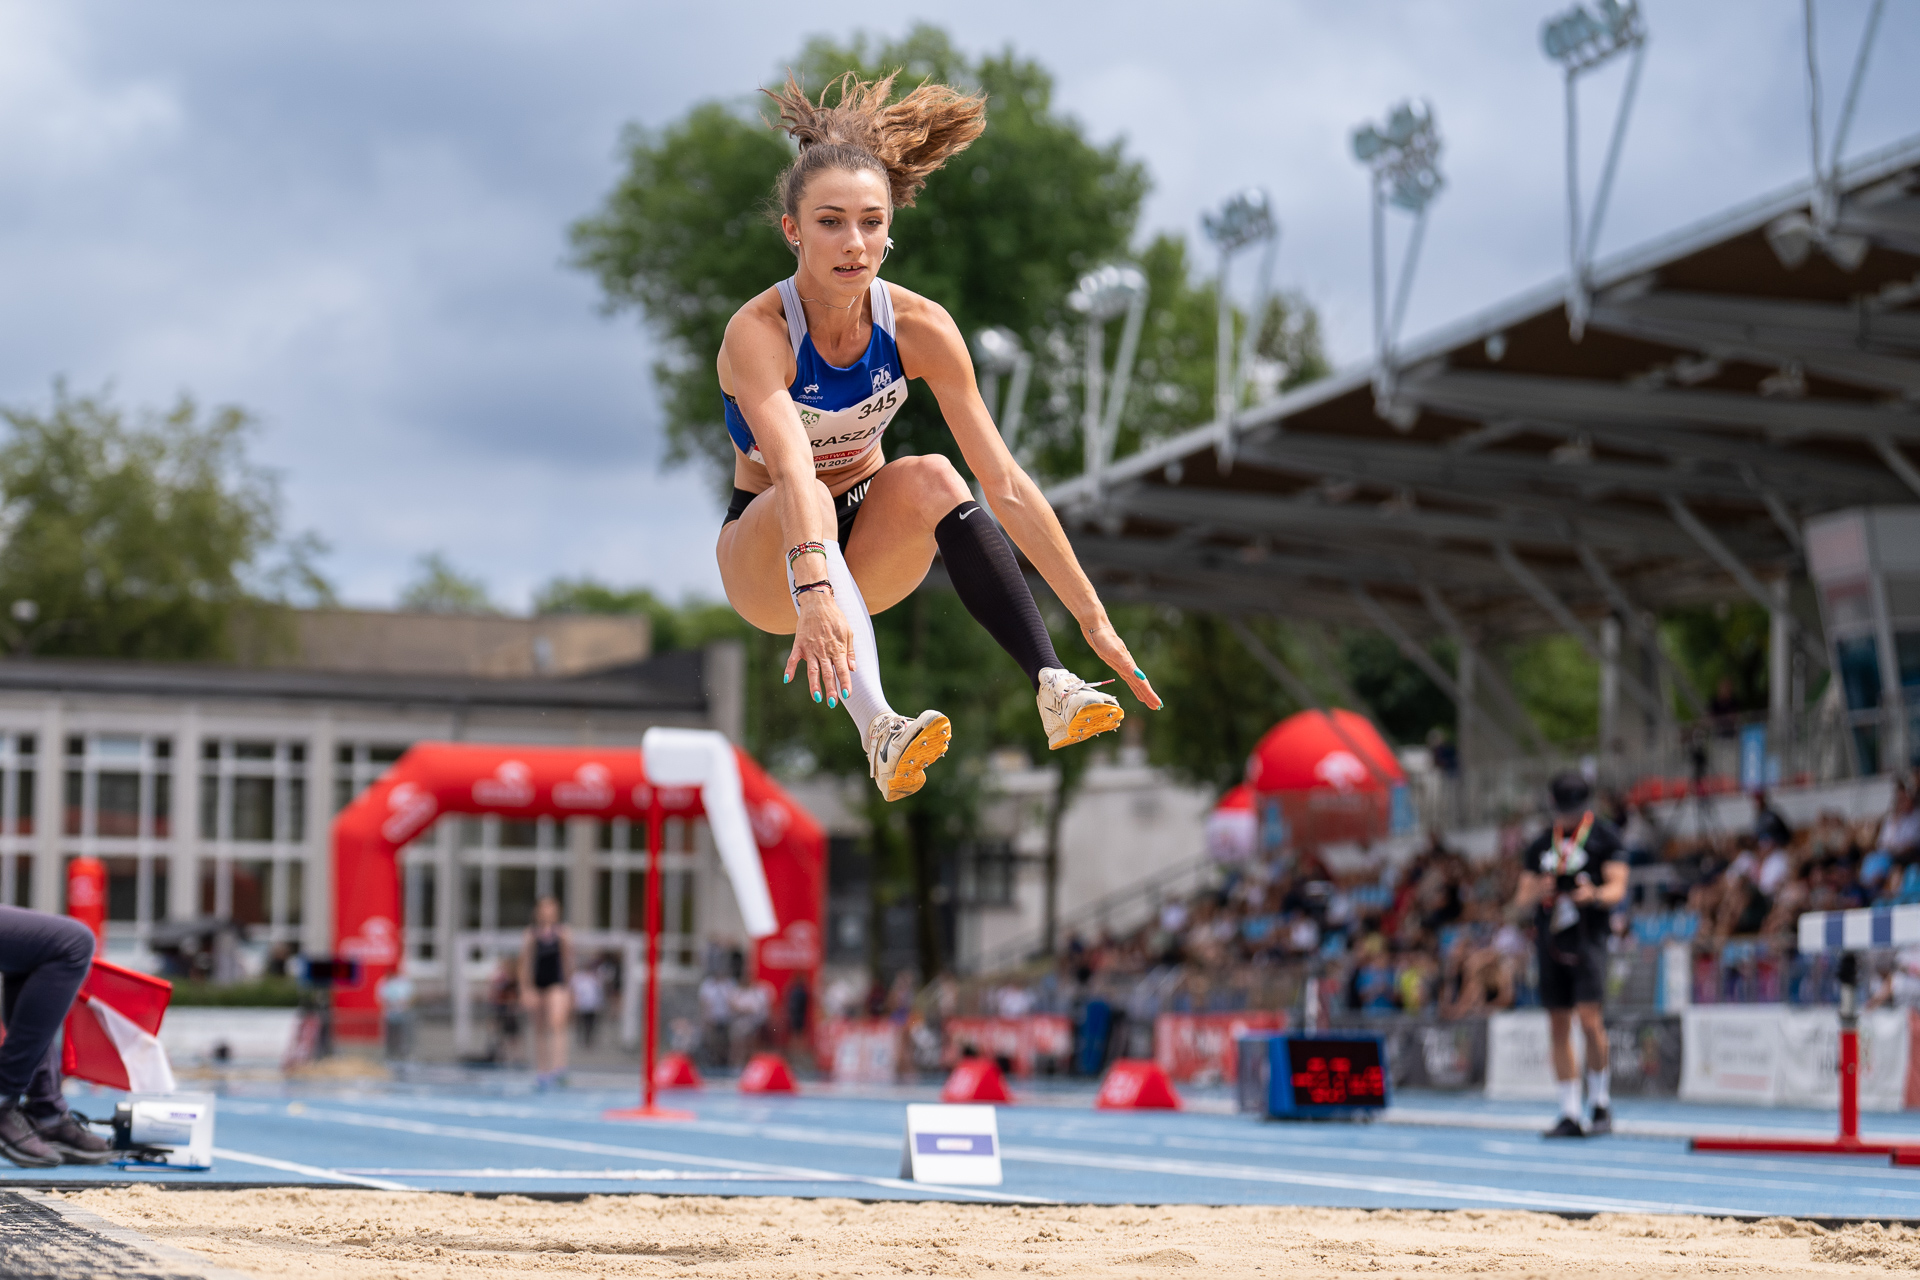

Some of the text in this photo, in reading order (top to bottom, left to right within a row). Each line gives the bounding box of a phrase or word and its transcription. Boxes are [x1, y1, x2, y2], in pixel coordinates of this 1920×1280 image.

[858, 389, 897, 420] 345
[813, 452, 846, 461] ZOSTWA
[828, 457, 854, 467] 2024
[847, 477, 874, 507] NIK
